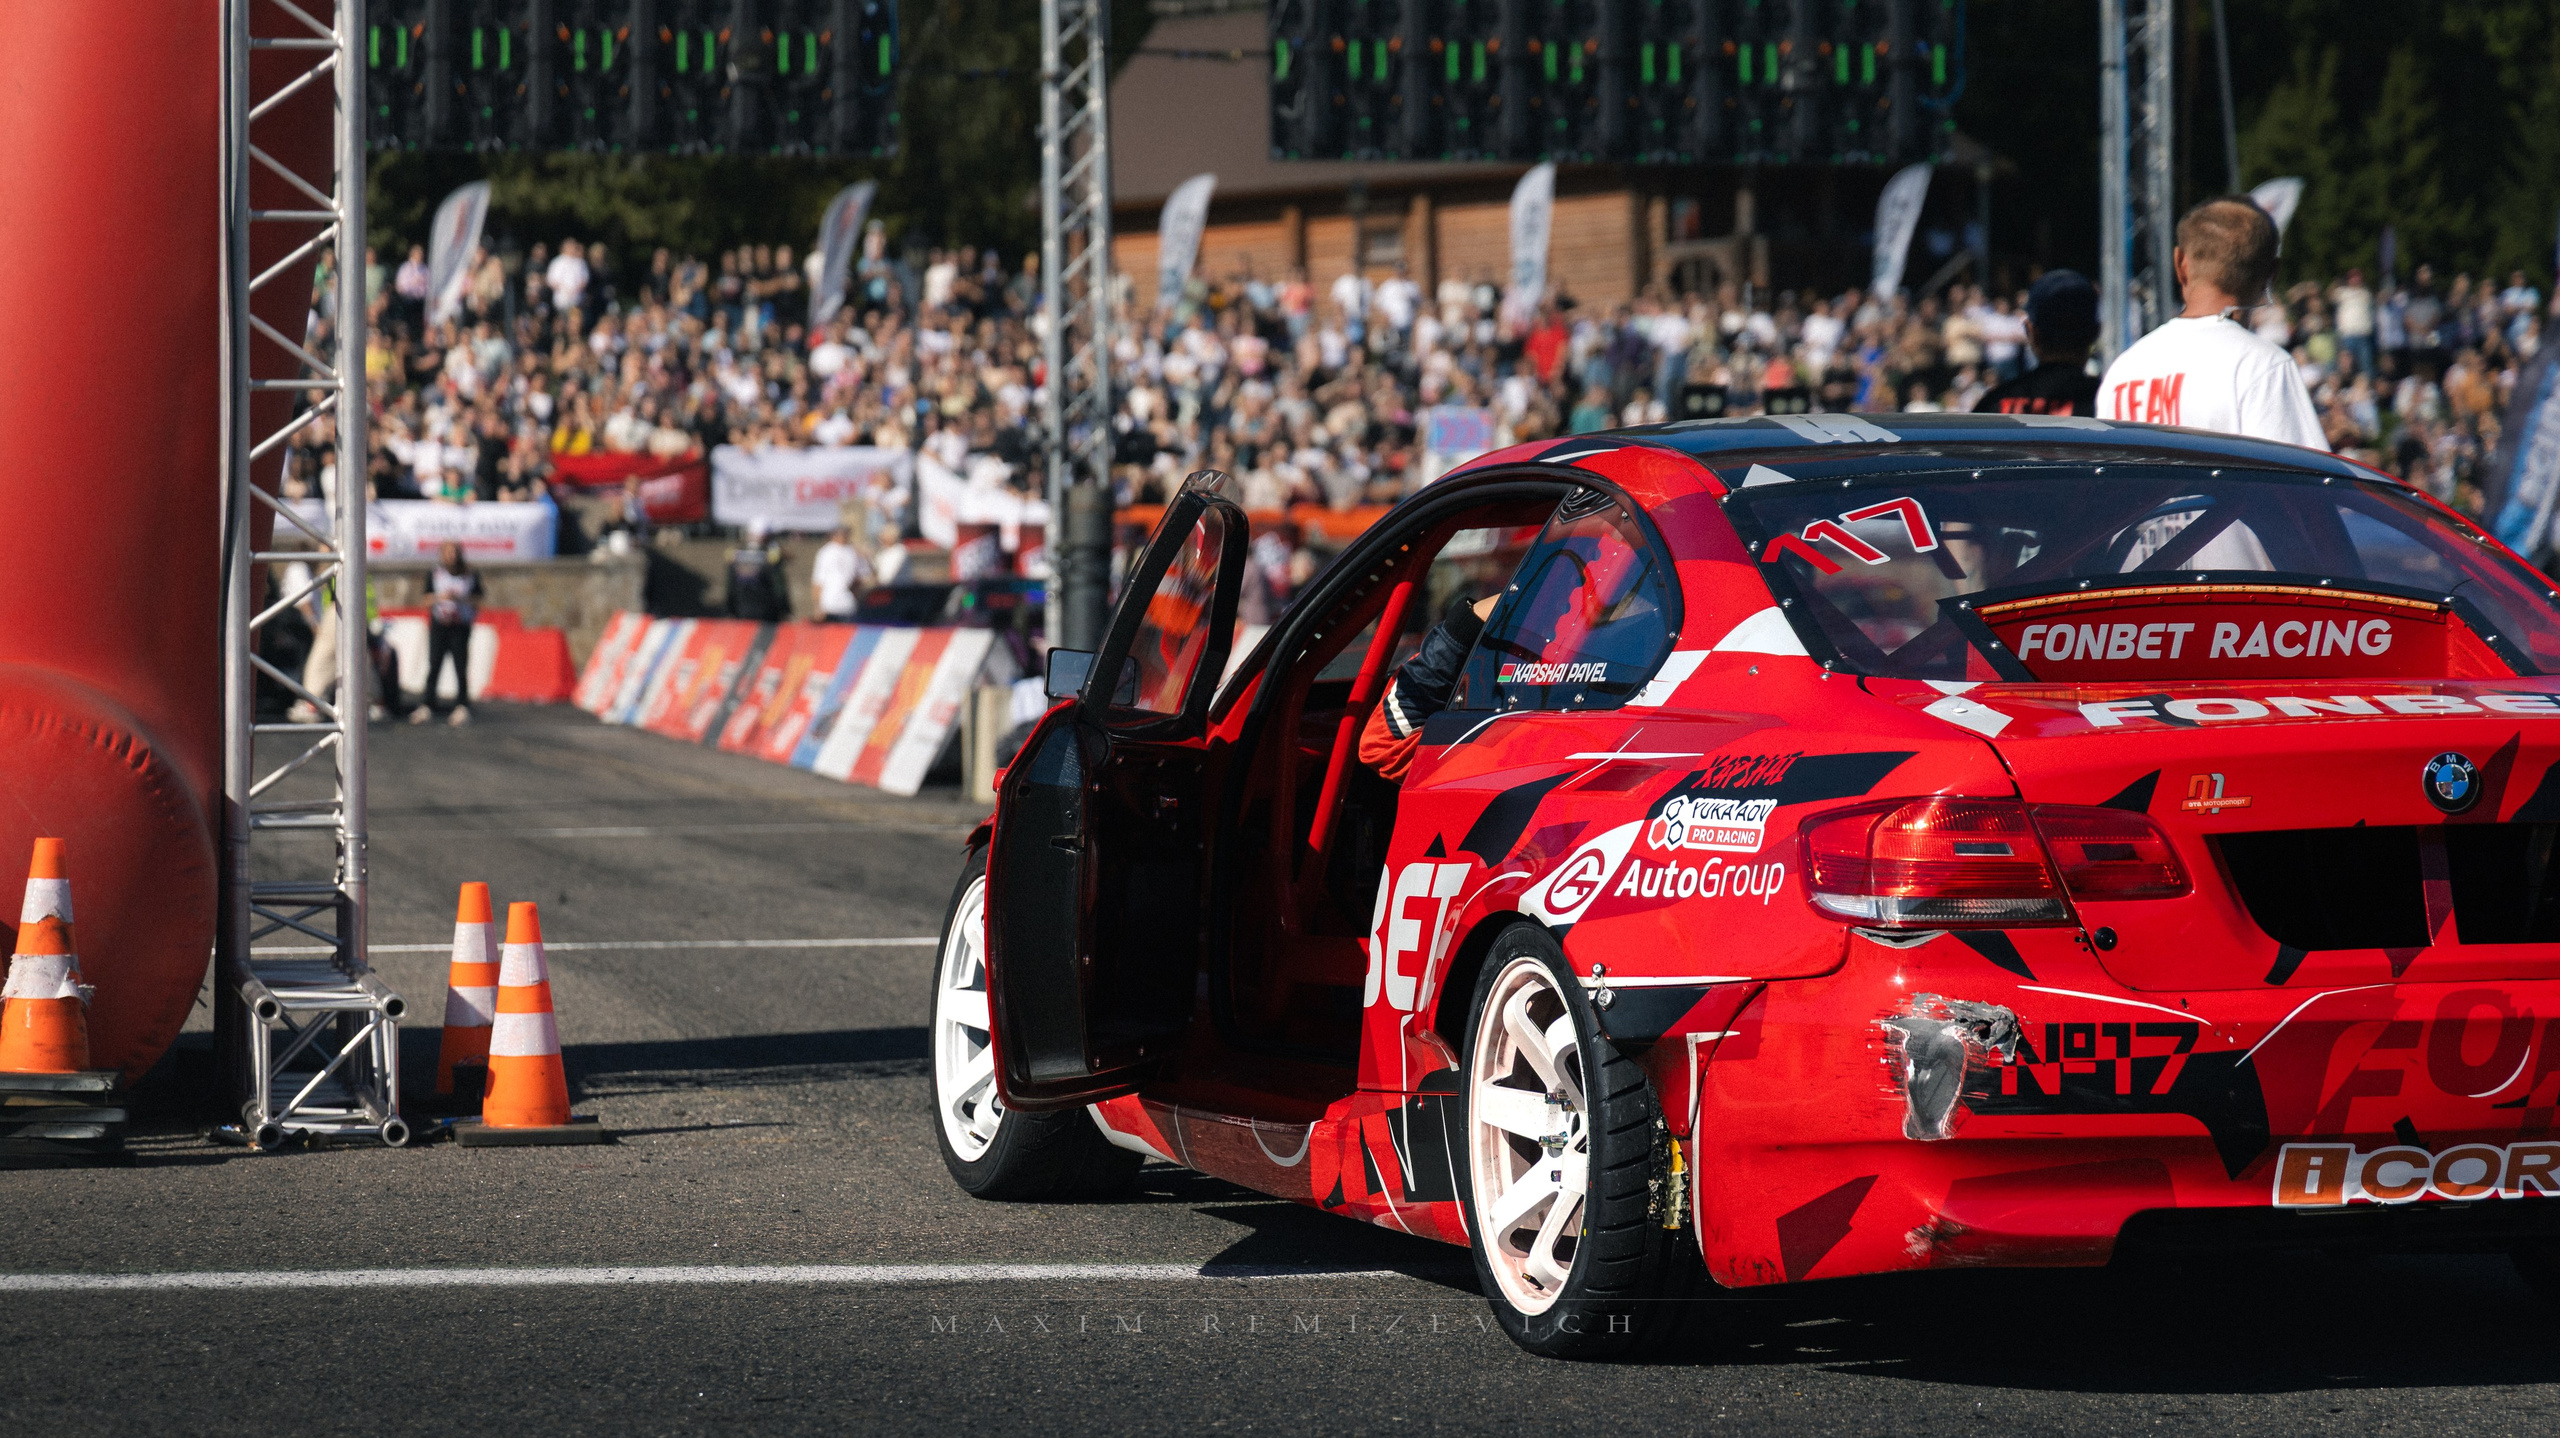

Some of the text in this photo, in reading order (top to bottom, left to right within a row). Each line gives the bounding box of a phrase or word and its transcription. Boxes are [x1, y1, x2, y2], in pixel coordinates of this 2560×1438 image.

[2114, 372, 2186, 426] TEAM
[2018, 619, 2393, 661] FONBET RACING
[1511, 662, 1608, 683] KAPSHAI PAVEL
[2078, 694, 2560, 727] FONBE
[2429, 754, 2474, 773] BMW
[1691, 828, 1756, 844] PRO RACING
[1613, 857, 1785, 906] AutoGroup
